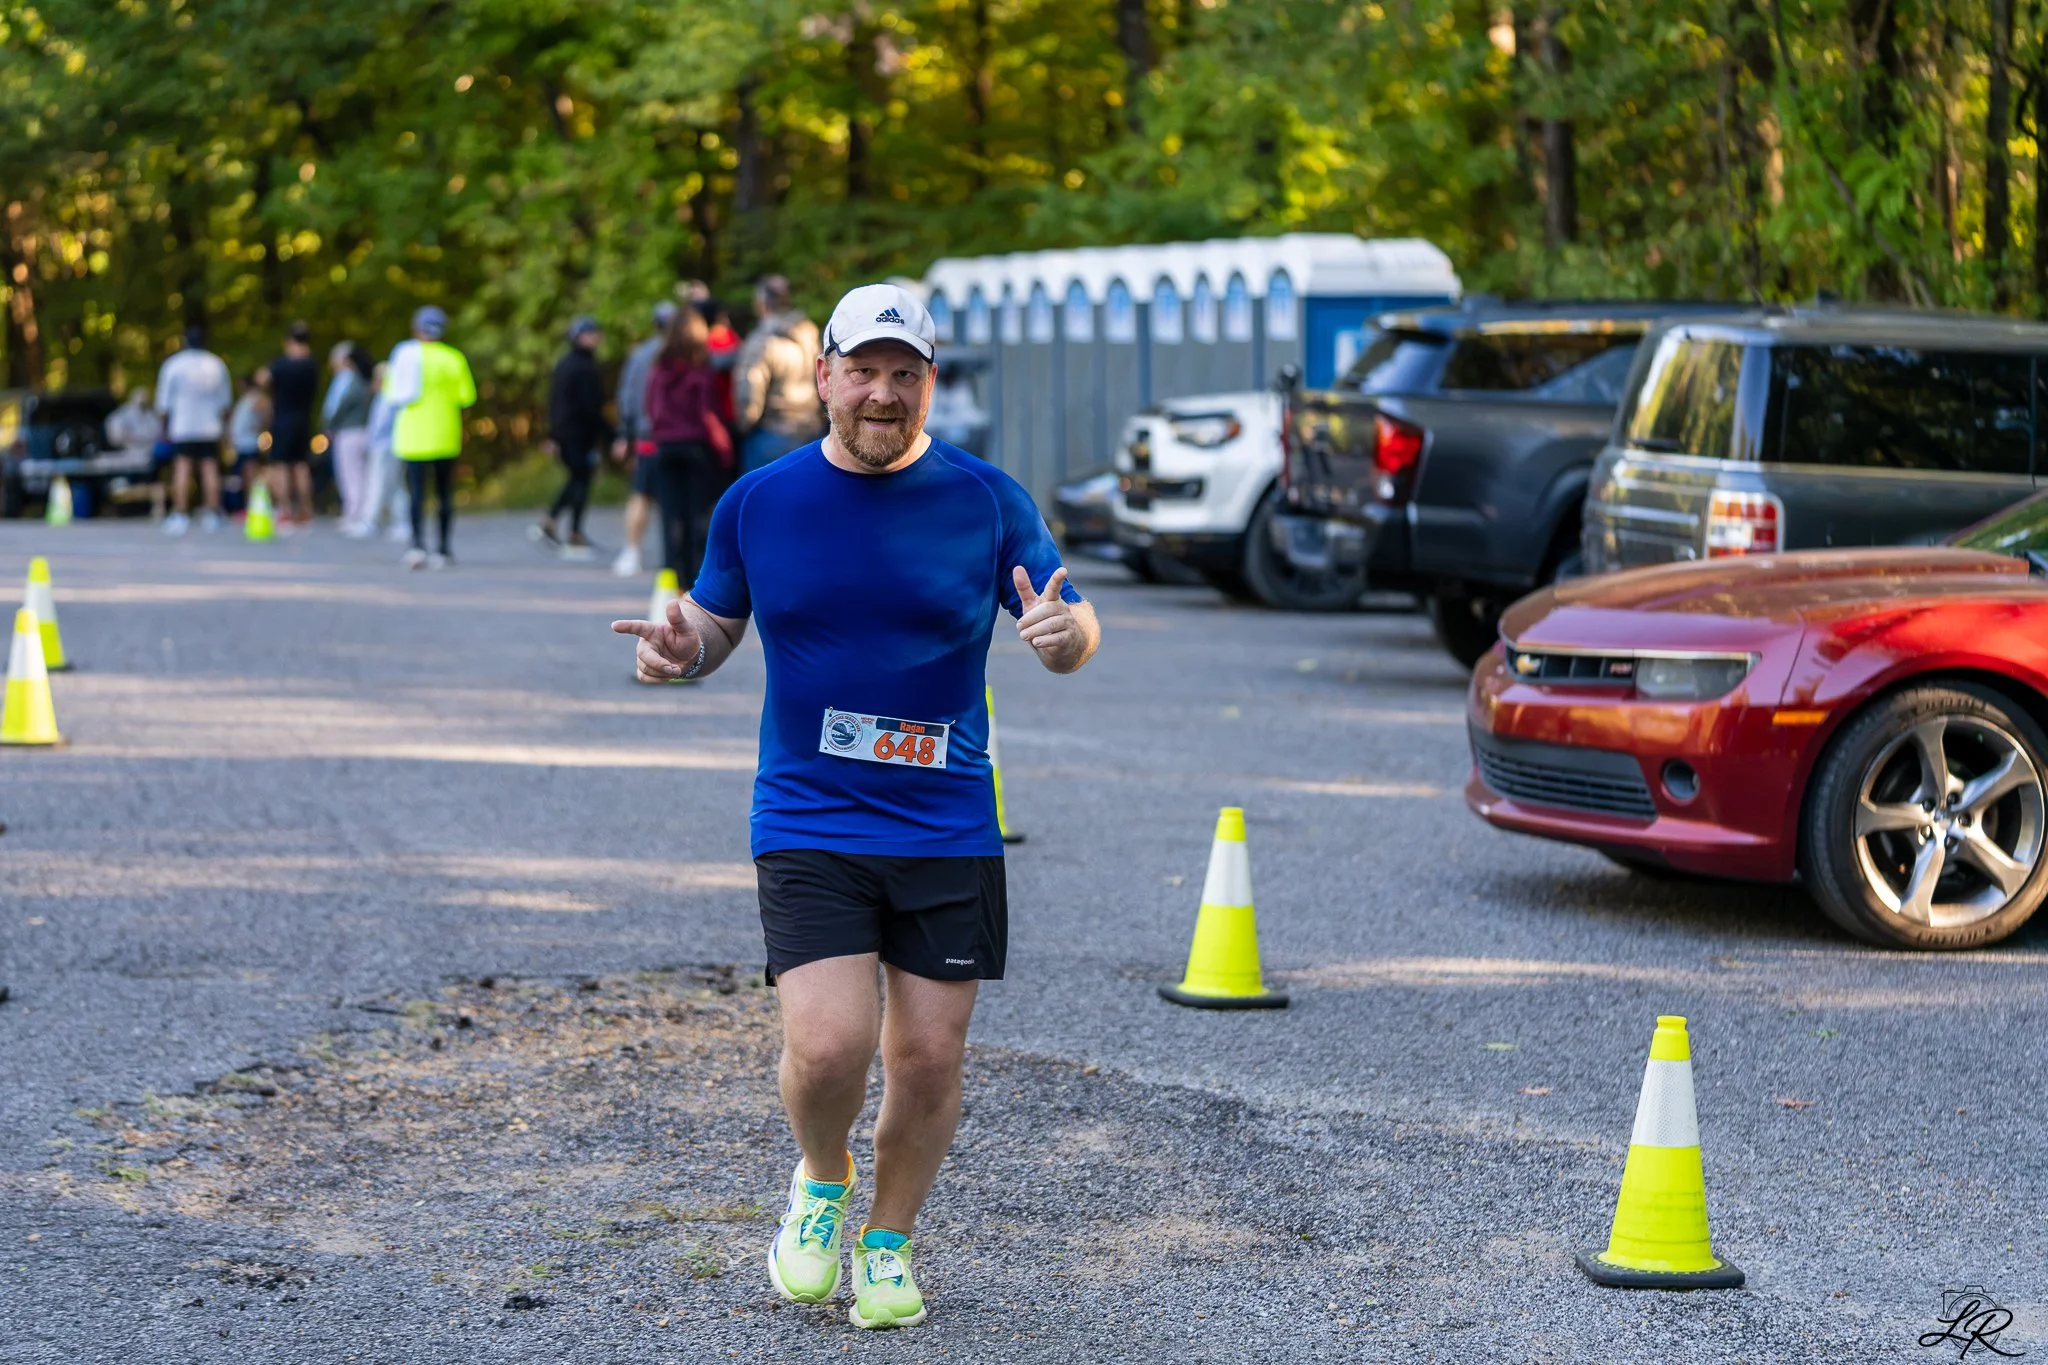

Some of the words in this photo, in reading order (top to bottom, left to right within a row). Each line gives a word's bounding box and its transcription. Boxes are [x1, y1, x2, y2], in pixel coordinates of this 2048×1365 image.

[876, 316, 904, 325] adidas
[900, 722, 925, 734] Ragan
[873, 732, 935, 765] 648
